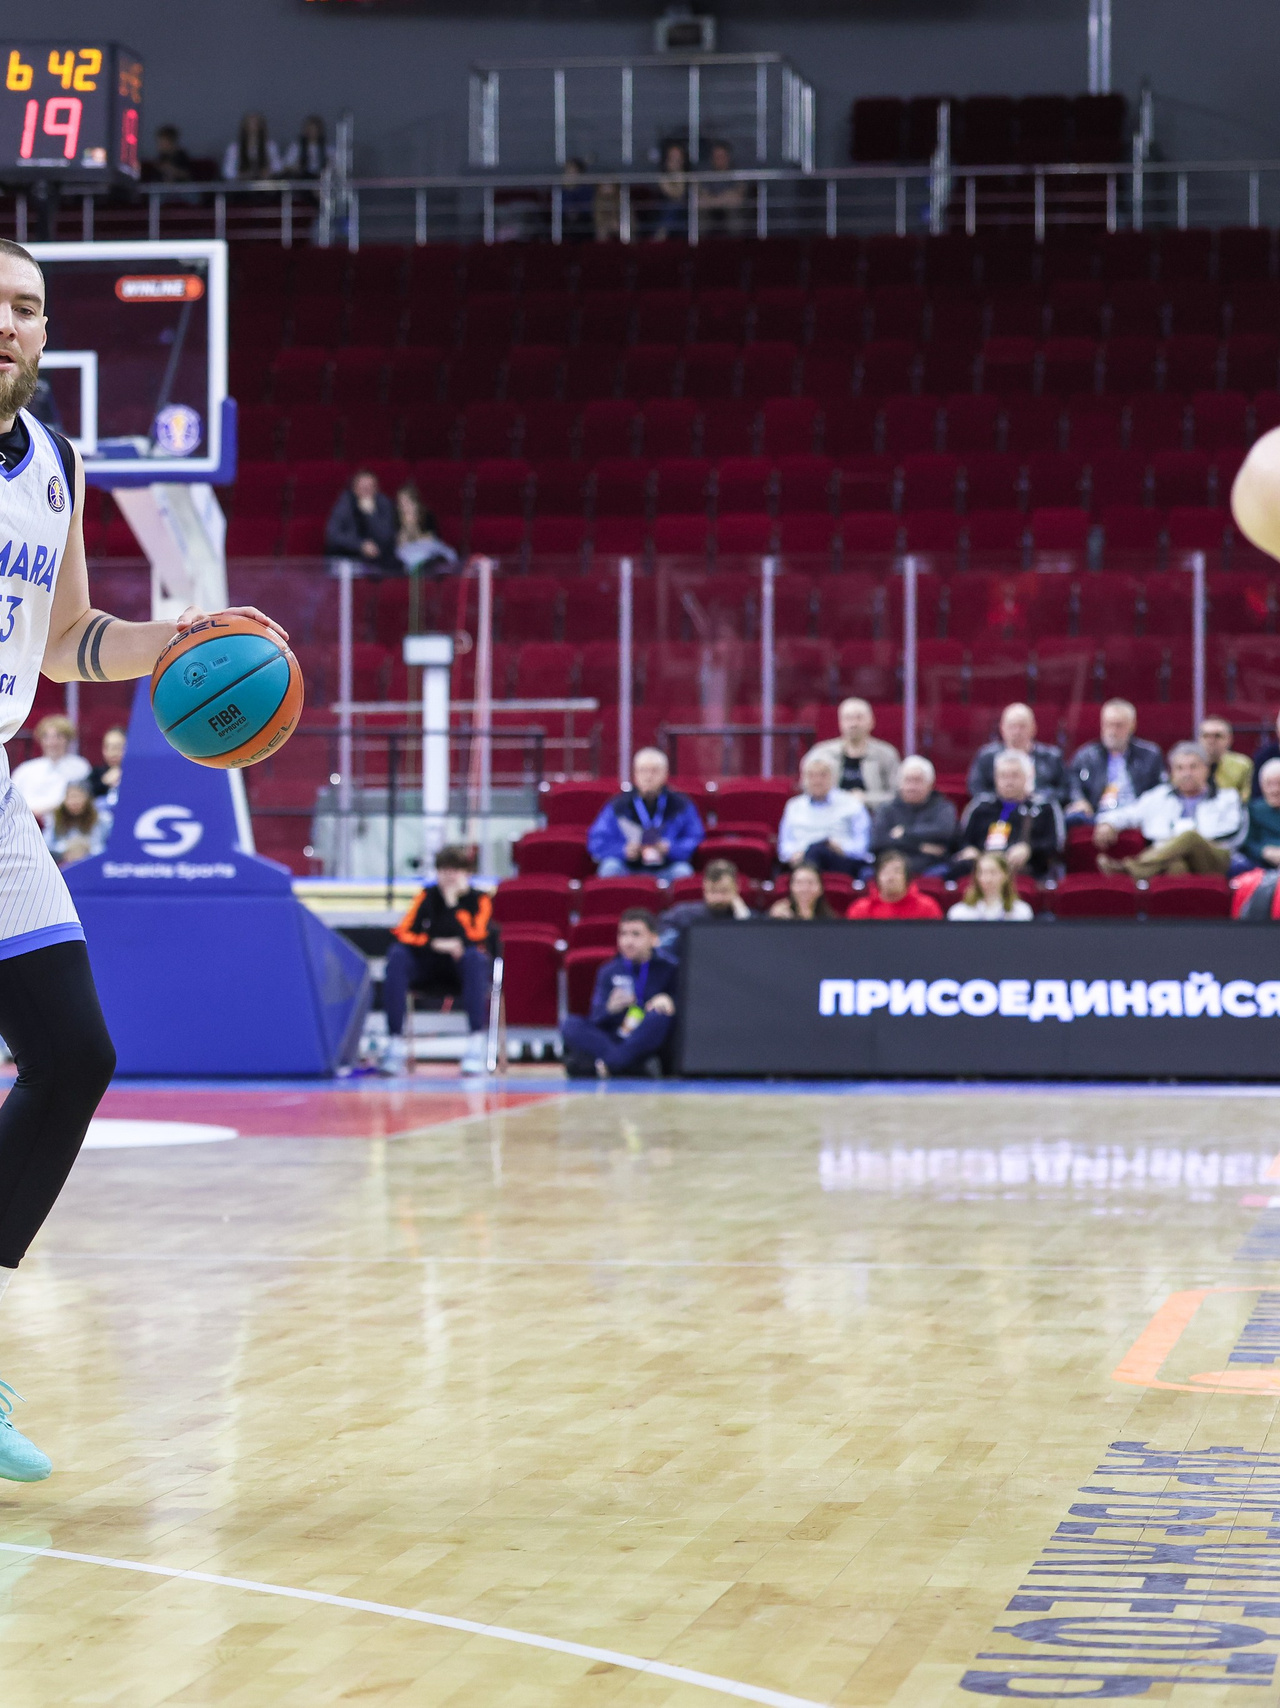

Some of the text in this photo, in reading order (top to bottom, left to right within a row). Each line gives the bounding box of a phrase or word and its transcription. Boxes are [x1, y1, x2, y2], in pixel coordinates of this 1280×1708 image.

[6, 50, 33, 91] 6
[48, 49, 102, 91] 42
[20, 97, 82, 159] 19
[208, 703, 242, 732] FIBA
[218, 715, 247, 738] APPROVED
[819, 971, 1280, 1022] ПРИСОЕДИНЯЙСЯ
